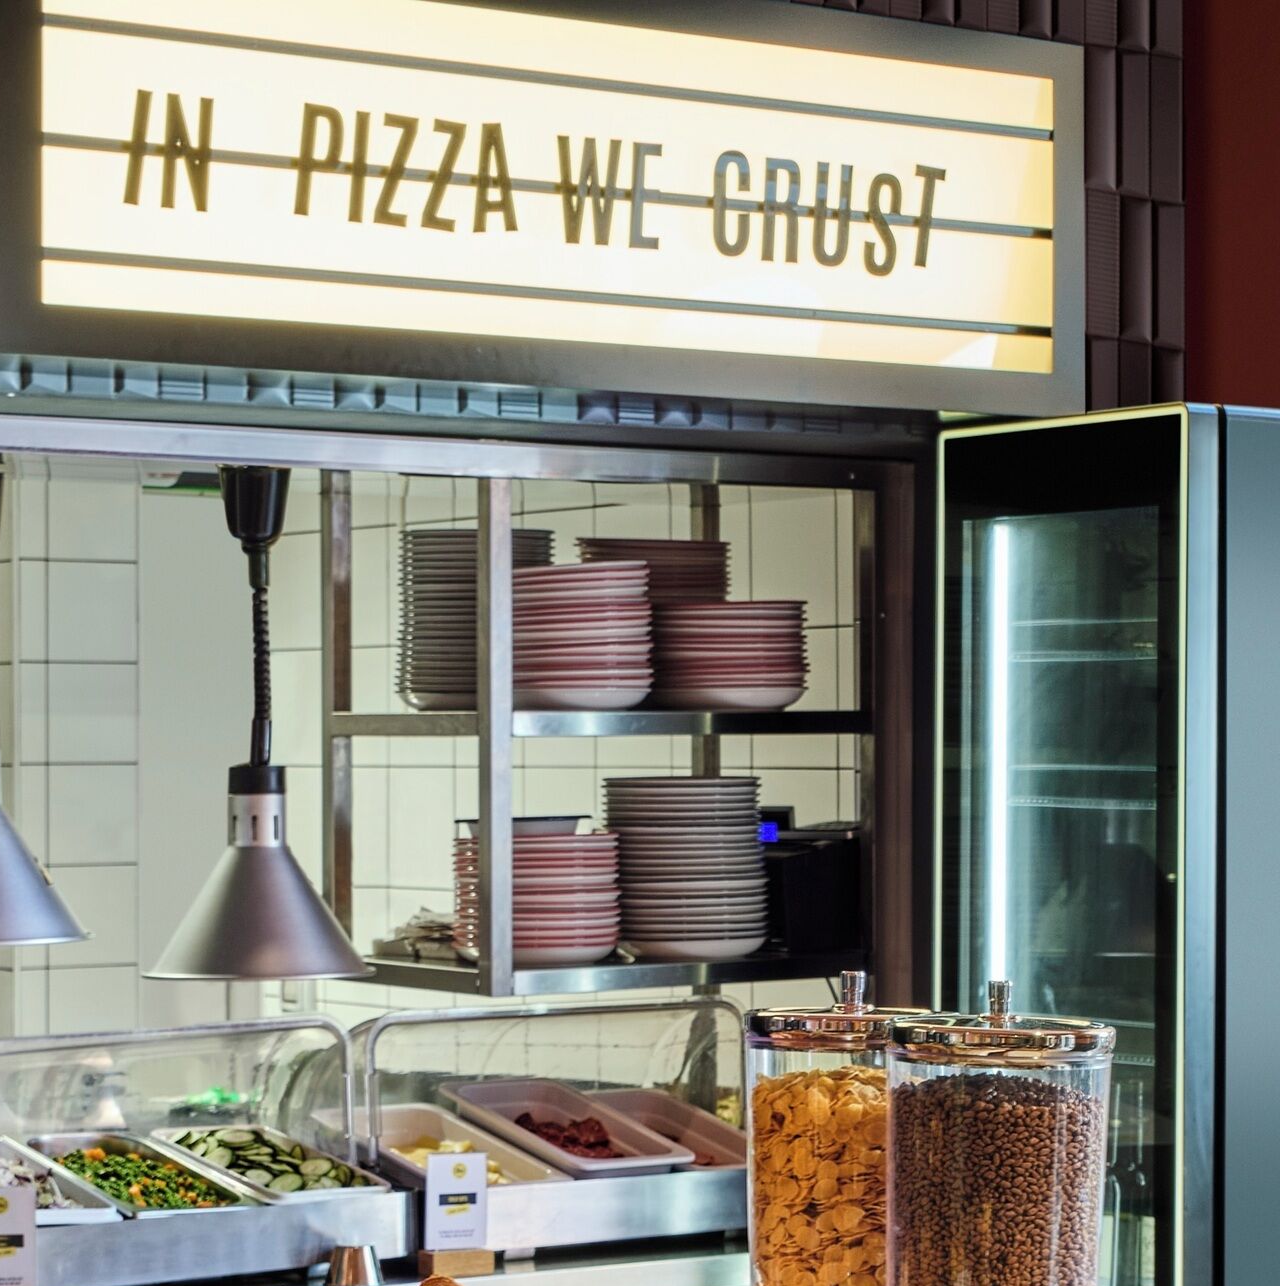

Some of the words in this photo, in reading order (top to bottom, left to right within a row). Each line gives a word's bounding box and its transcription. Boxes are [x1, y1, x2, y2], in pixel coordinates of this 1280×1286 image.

[123, 89, 214, 212] IN
[294, 102, 518, 233] PIZZA
[557, 135, 663, 250] WE
[713, 150, 947, 277] CRUST
